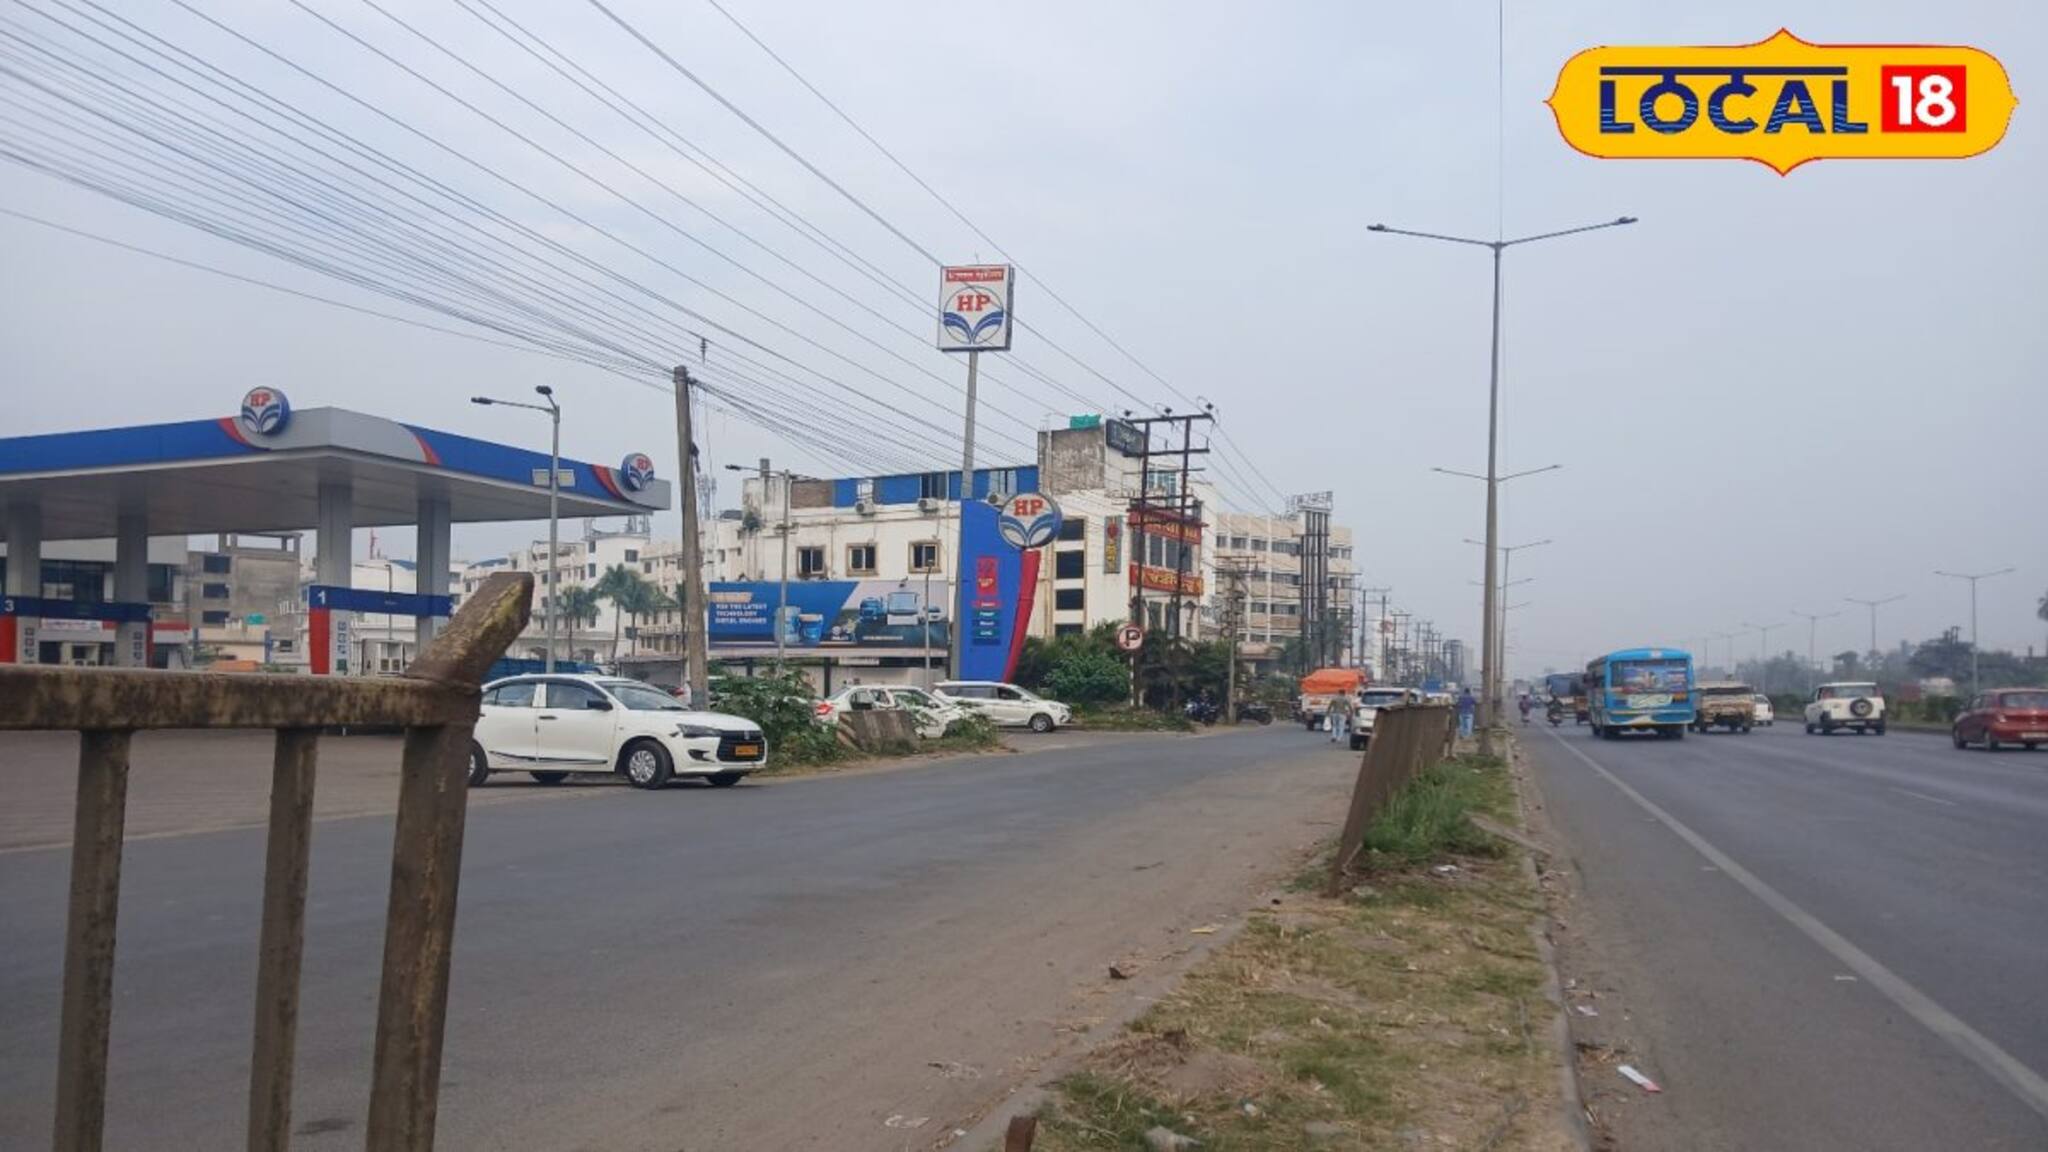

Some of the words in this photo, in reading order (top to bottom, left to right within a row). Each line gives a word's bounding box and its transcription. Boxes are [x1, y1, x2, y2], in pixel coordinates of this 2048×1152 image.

[957, 294, 991, 312] HP
[250, 393, 271, 407] HP
[1014, 499, 1044, 516] HP
[318, 590, 326, 605] 1
[4, 599, 14, 612] 3
